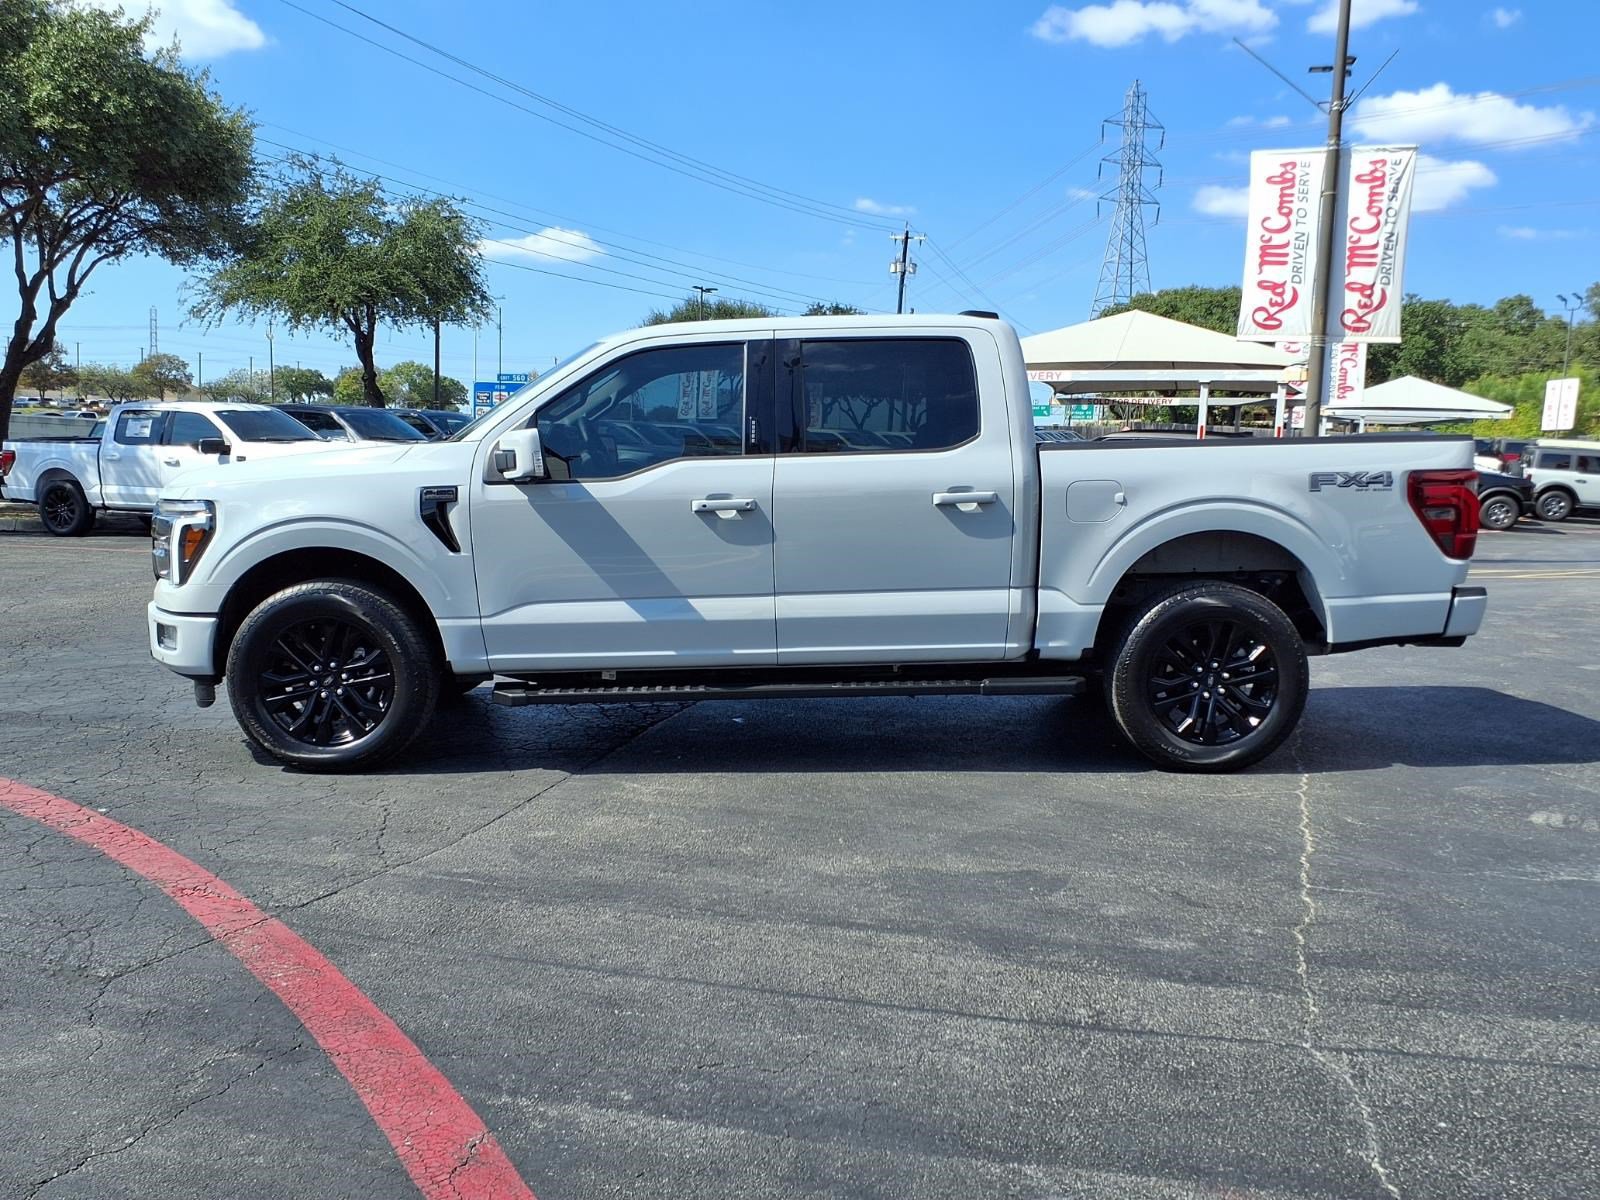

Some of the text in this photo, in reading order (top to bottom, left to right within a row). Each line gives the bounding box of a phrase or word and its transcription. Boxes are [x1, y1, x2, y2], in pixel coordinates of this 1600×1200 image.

[1258, 161, 1298, 275] McCombs
[1291, 160, 1311, 285] DRIVEN TO SERVE
[1340, 158, 1388, 333] Red McCombs
[1380, 158, 1402, 286] DRIVEN TO SERVE
[1252, 279, 1299, 331] Red
[1030, 371, 1062, 381] VERY
[1309, 471, 1394, 492] FX4
